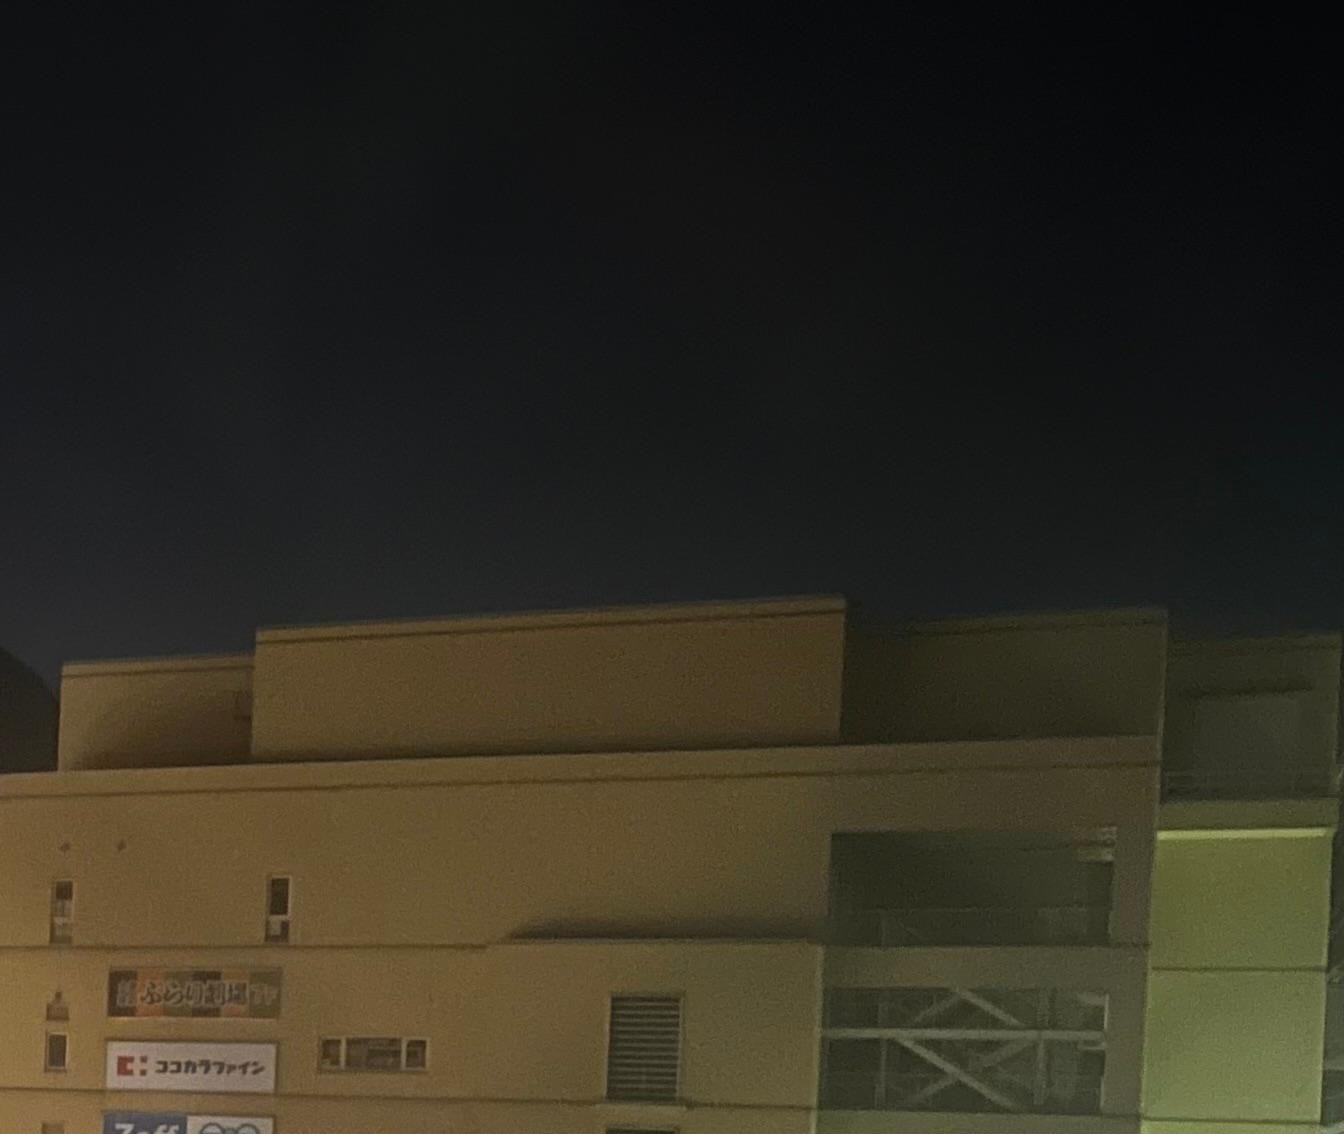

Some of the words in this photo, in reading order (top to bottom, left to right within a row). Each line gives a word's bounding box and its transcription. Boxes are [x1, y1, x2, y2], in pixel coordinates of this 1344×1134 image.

[155, 1060, 265, 1075] ココカラファイン
